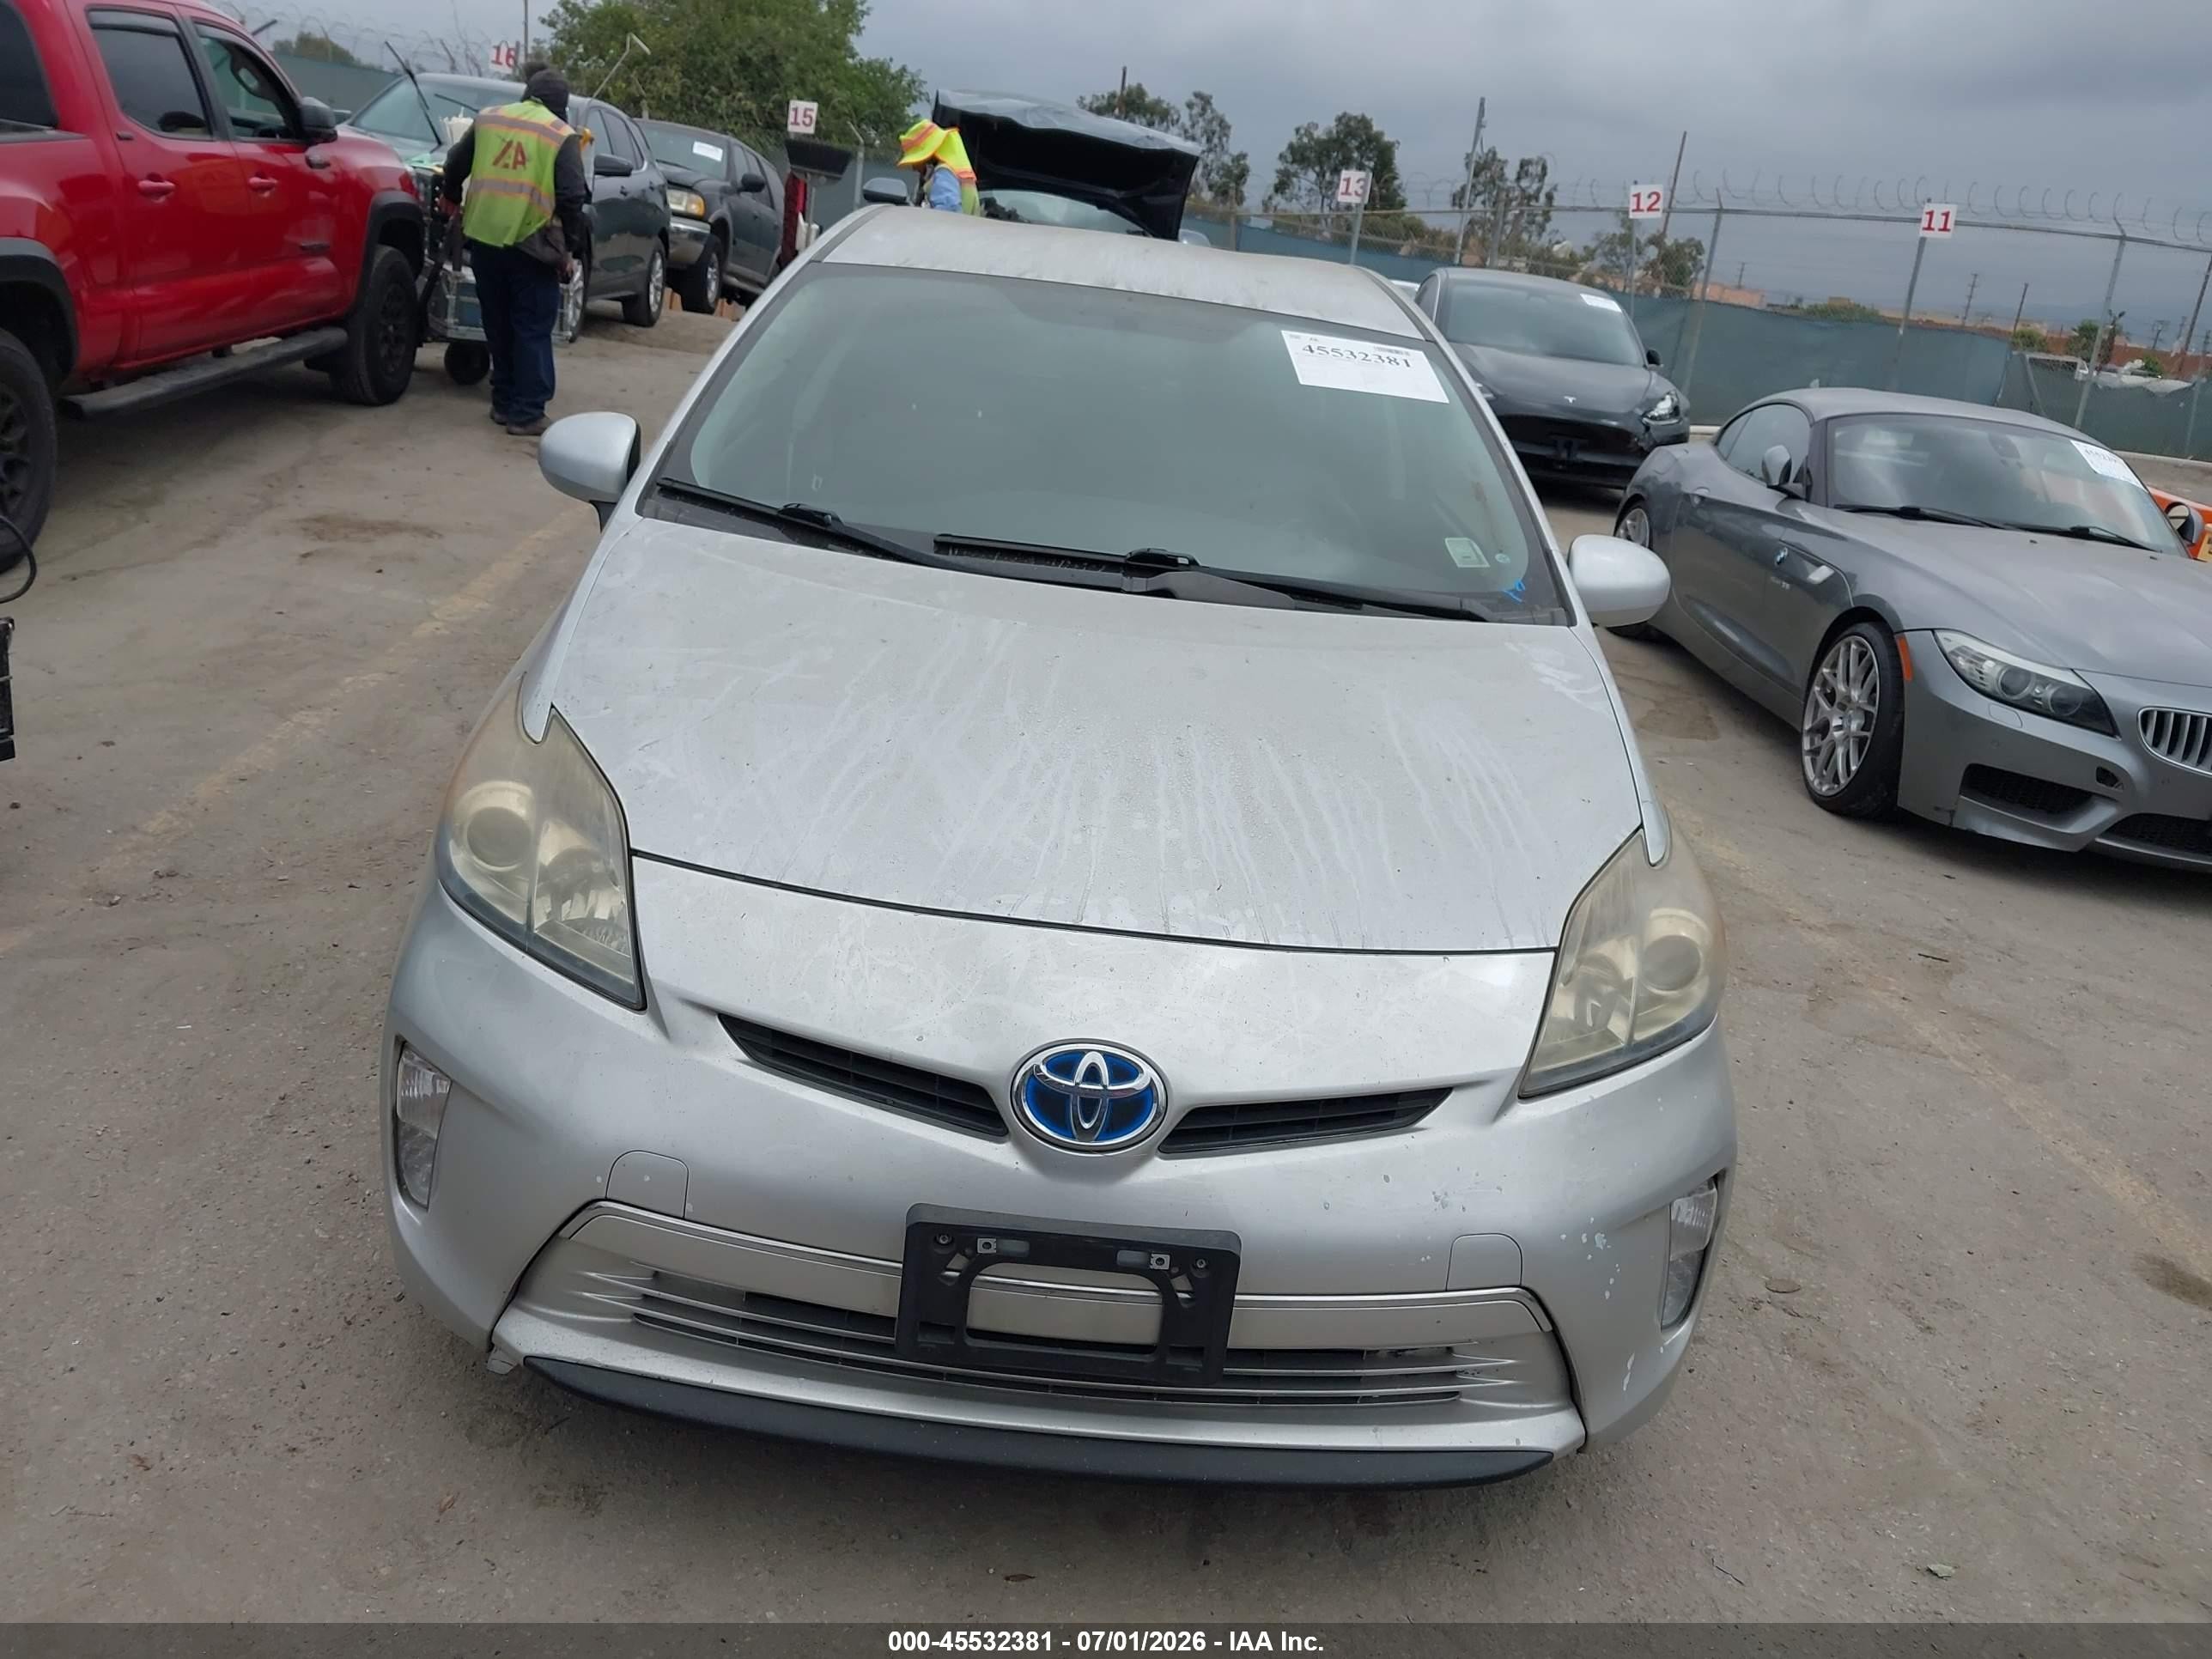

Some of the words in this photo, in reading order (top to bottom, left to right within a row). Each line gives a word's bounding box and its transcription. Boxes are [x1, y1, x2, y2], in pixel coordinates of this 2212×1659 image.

[491, 46, 517, 68] 16
[790, 107, 814, 127] 15
[1340, 177, 1368, 197] 13
[1632, 191, 1661, 212] 12
[1922, 210, 1951, 232] 11
[1302, 344, 1411, 368] 45532381
